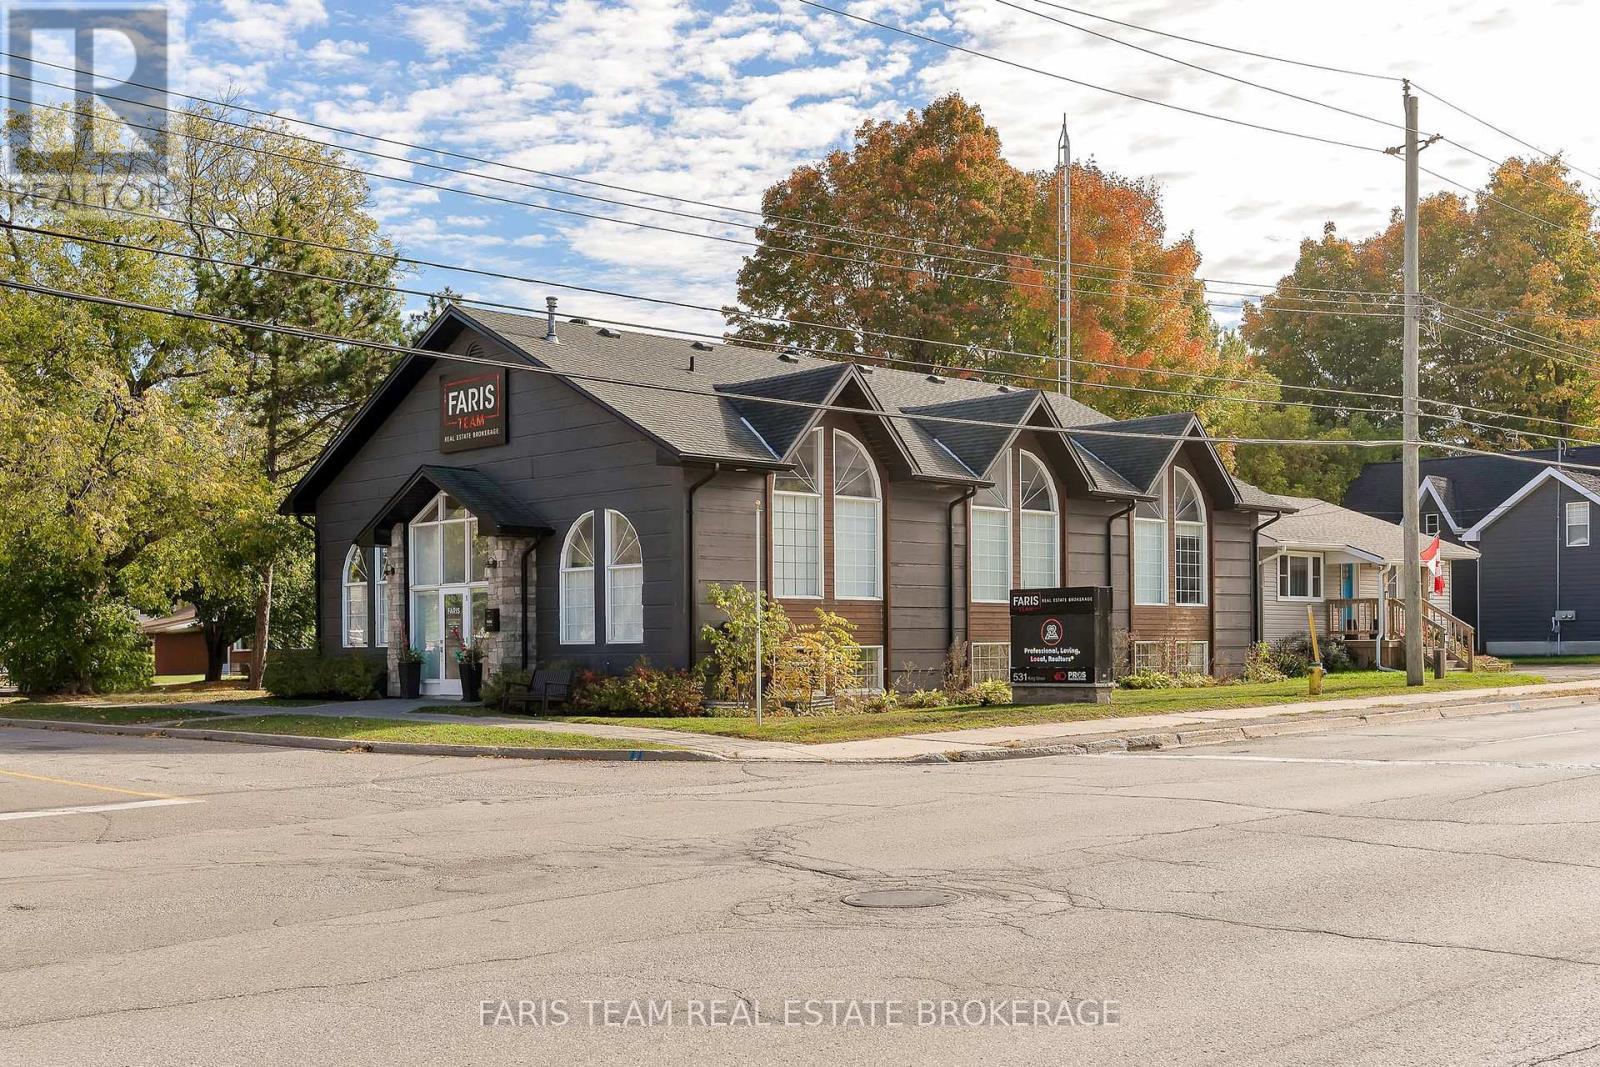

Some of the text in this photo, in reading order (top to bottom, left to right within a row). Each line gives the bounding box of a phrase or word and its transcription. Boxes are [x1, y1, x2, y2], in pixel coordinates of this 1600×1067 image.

[448, 384, 495, 416] FARIS
[458, 416, 485, 429] TEAM
[473, 429, 499, 438] BROKERAGE
[1014, 596, 1039, 606] FARIS
[1060, 648, 1080, 656] Loving,
[1013, 672, 1028, 682] 531
